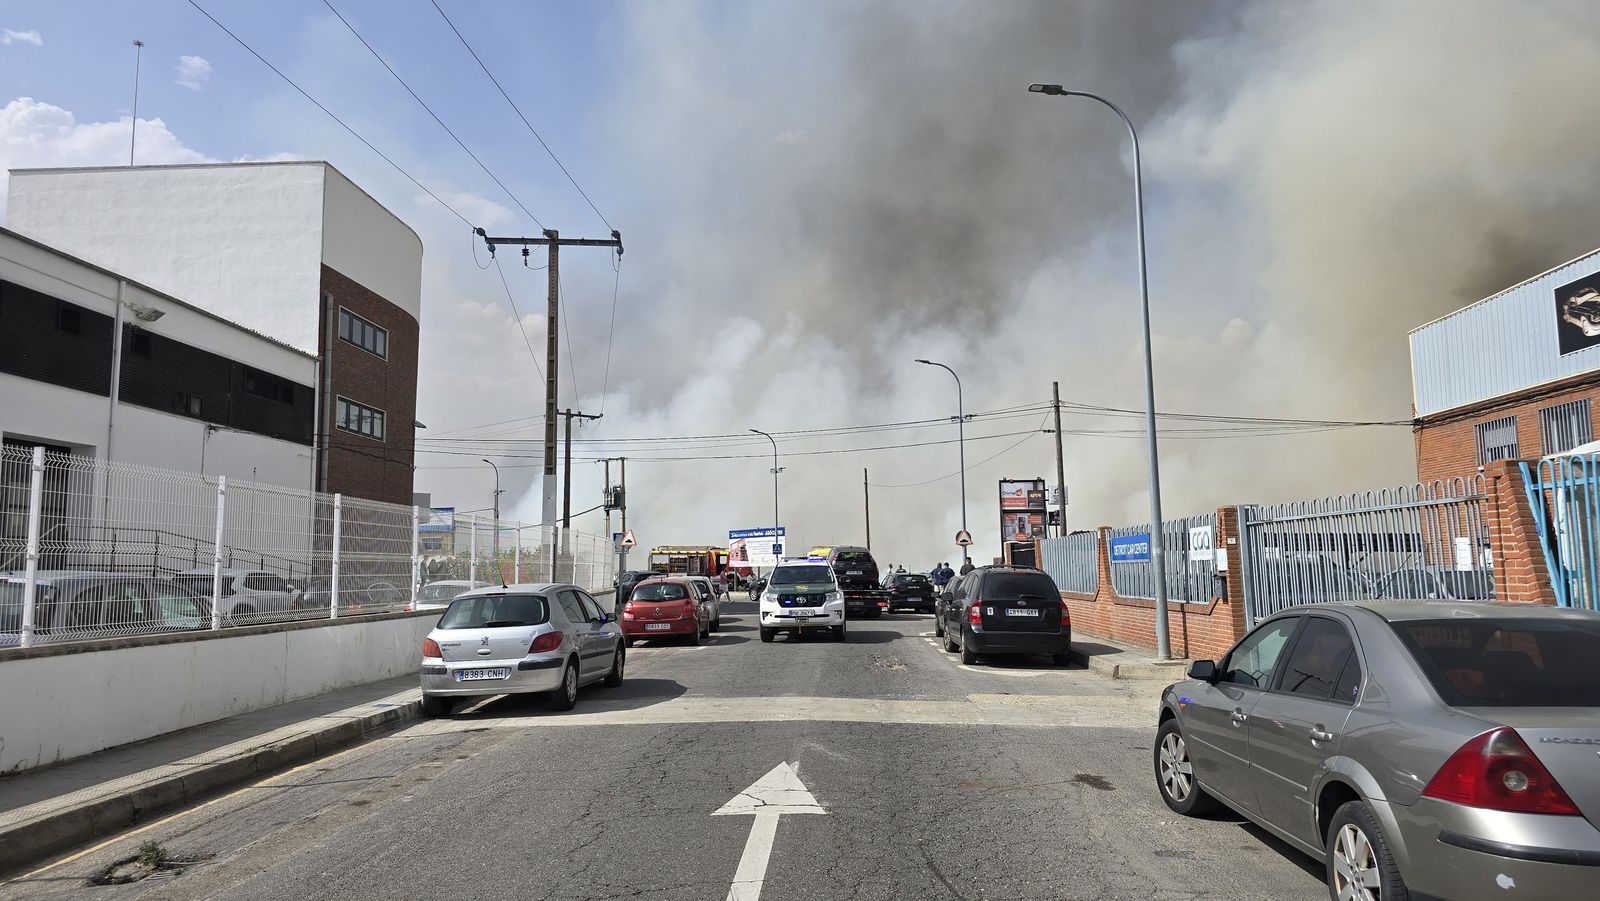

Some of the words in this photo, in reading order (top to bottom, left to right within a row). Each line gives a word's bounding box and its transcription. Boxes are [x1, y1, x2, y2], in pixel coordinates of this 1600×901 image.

[1113, 544, 1127, 556] DETROIT
[1135, 542, 1148, 555] CENTER
[464, 670, 484, 679] 8383
[487, 669, 503, 678] CNH
